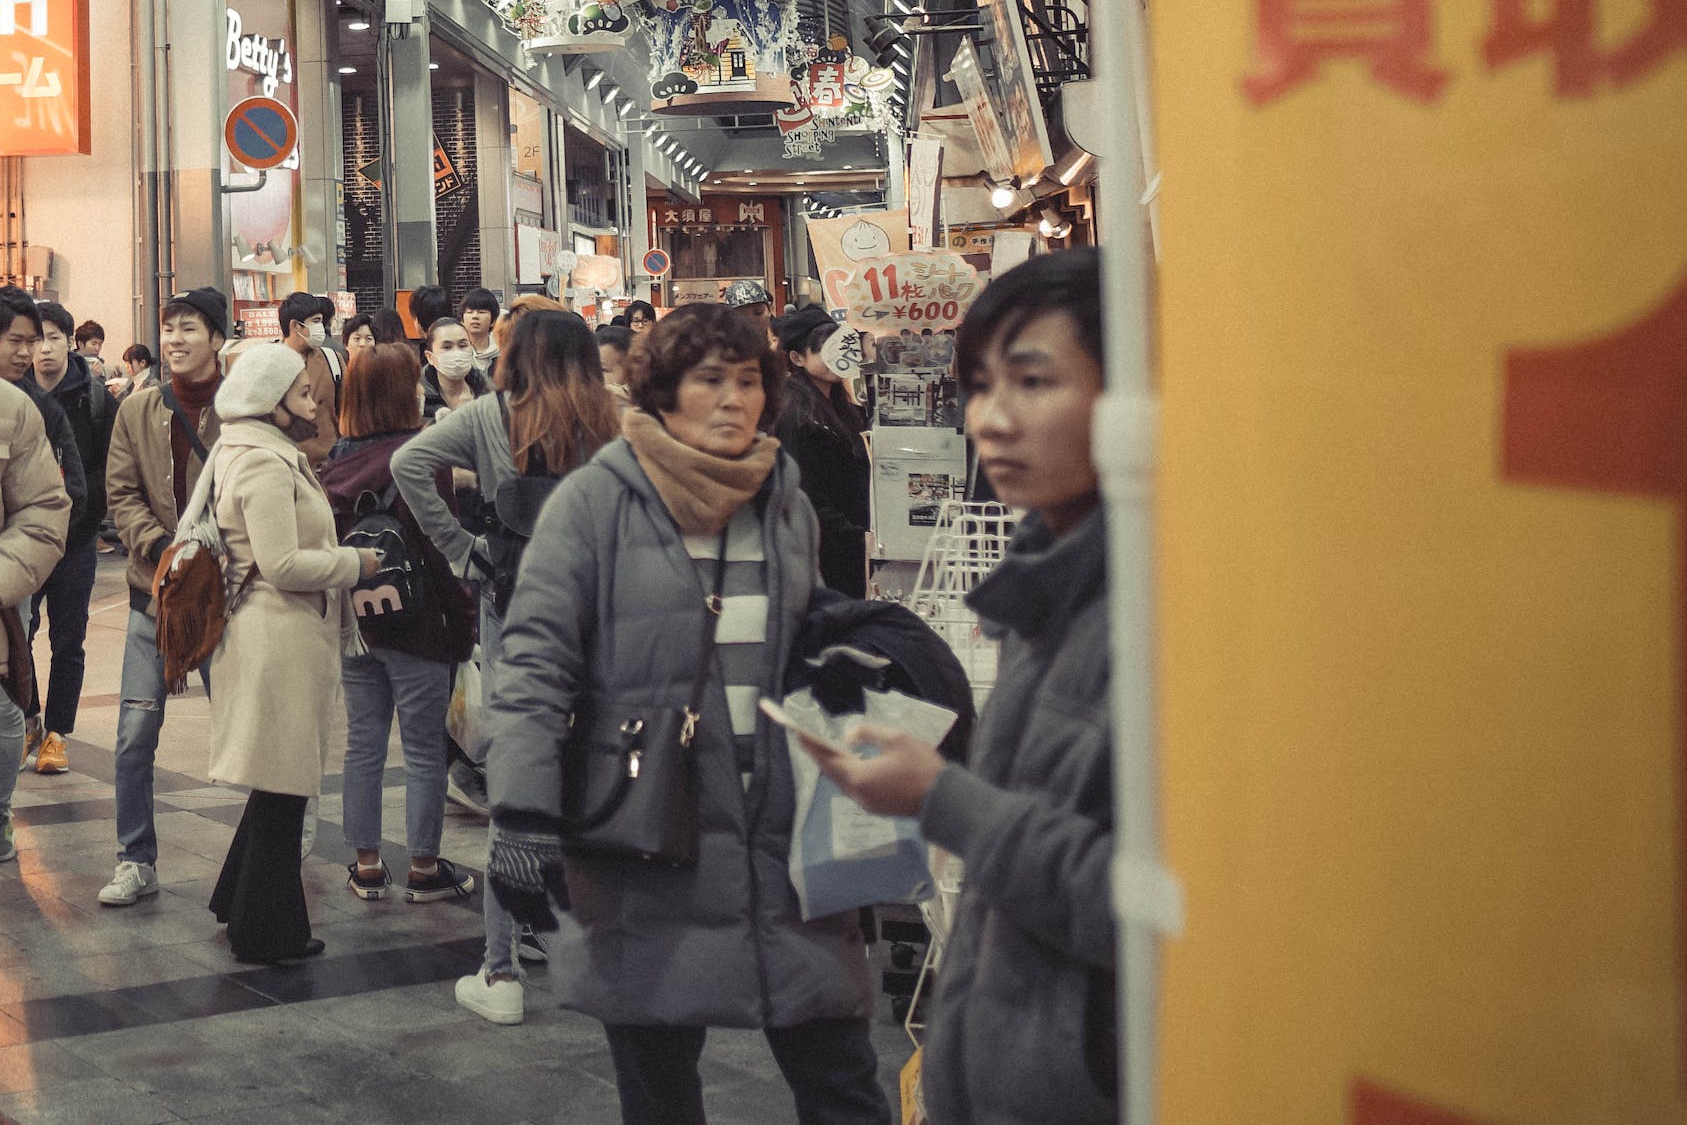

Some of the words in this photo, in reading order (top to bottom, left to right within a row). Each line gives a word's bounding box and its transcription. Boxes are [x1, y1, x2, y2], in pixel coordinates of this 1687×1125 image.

[226, 8, 292, 98] Betty's
[813, 65, 842, 105] 春
[524, 145, 540, 158] 2F
[664, 208, 712, 223] 大須屋
[893, 300, 959, 321] ¥600
